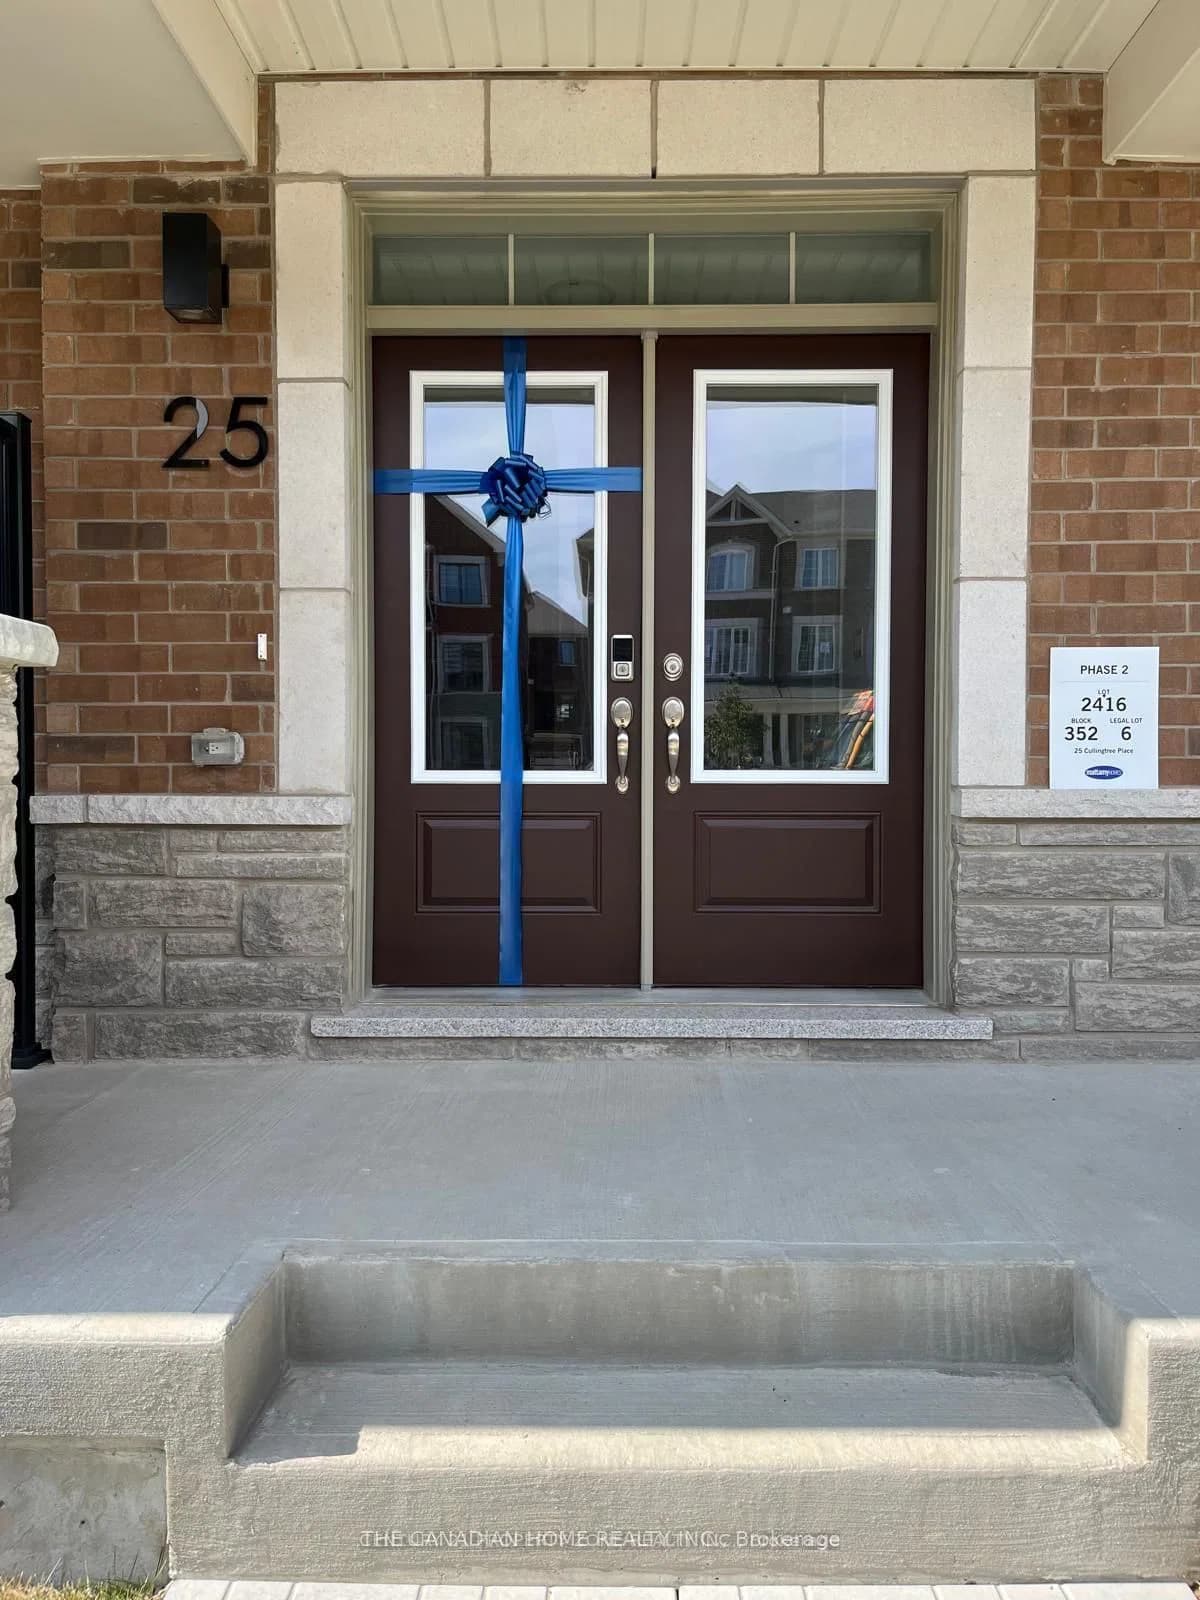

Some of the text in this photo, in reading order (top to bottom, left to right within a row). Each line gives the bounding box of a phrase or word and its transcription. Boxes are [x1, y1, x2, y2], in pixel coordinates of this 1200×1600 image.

[161, 396, 269, 468] 25
[1080, 665, 1129, 675] PHASE 2
[1081, 697, 1127, 712] 2416
[1064, 726, 1098, 741] 352
[1121, 726, 1132, 741] 6
[1084, 747, 1116, 755] Cullingtree
